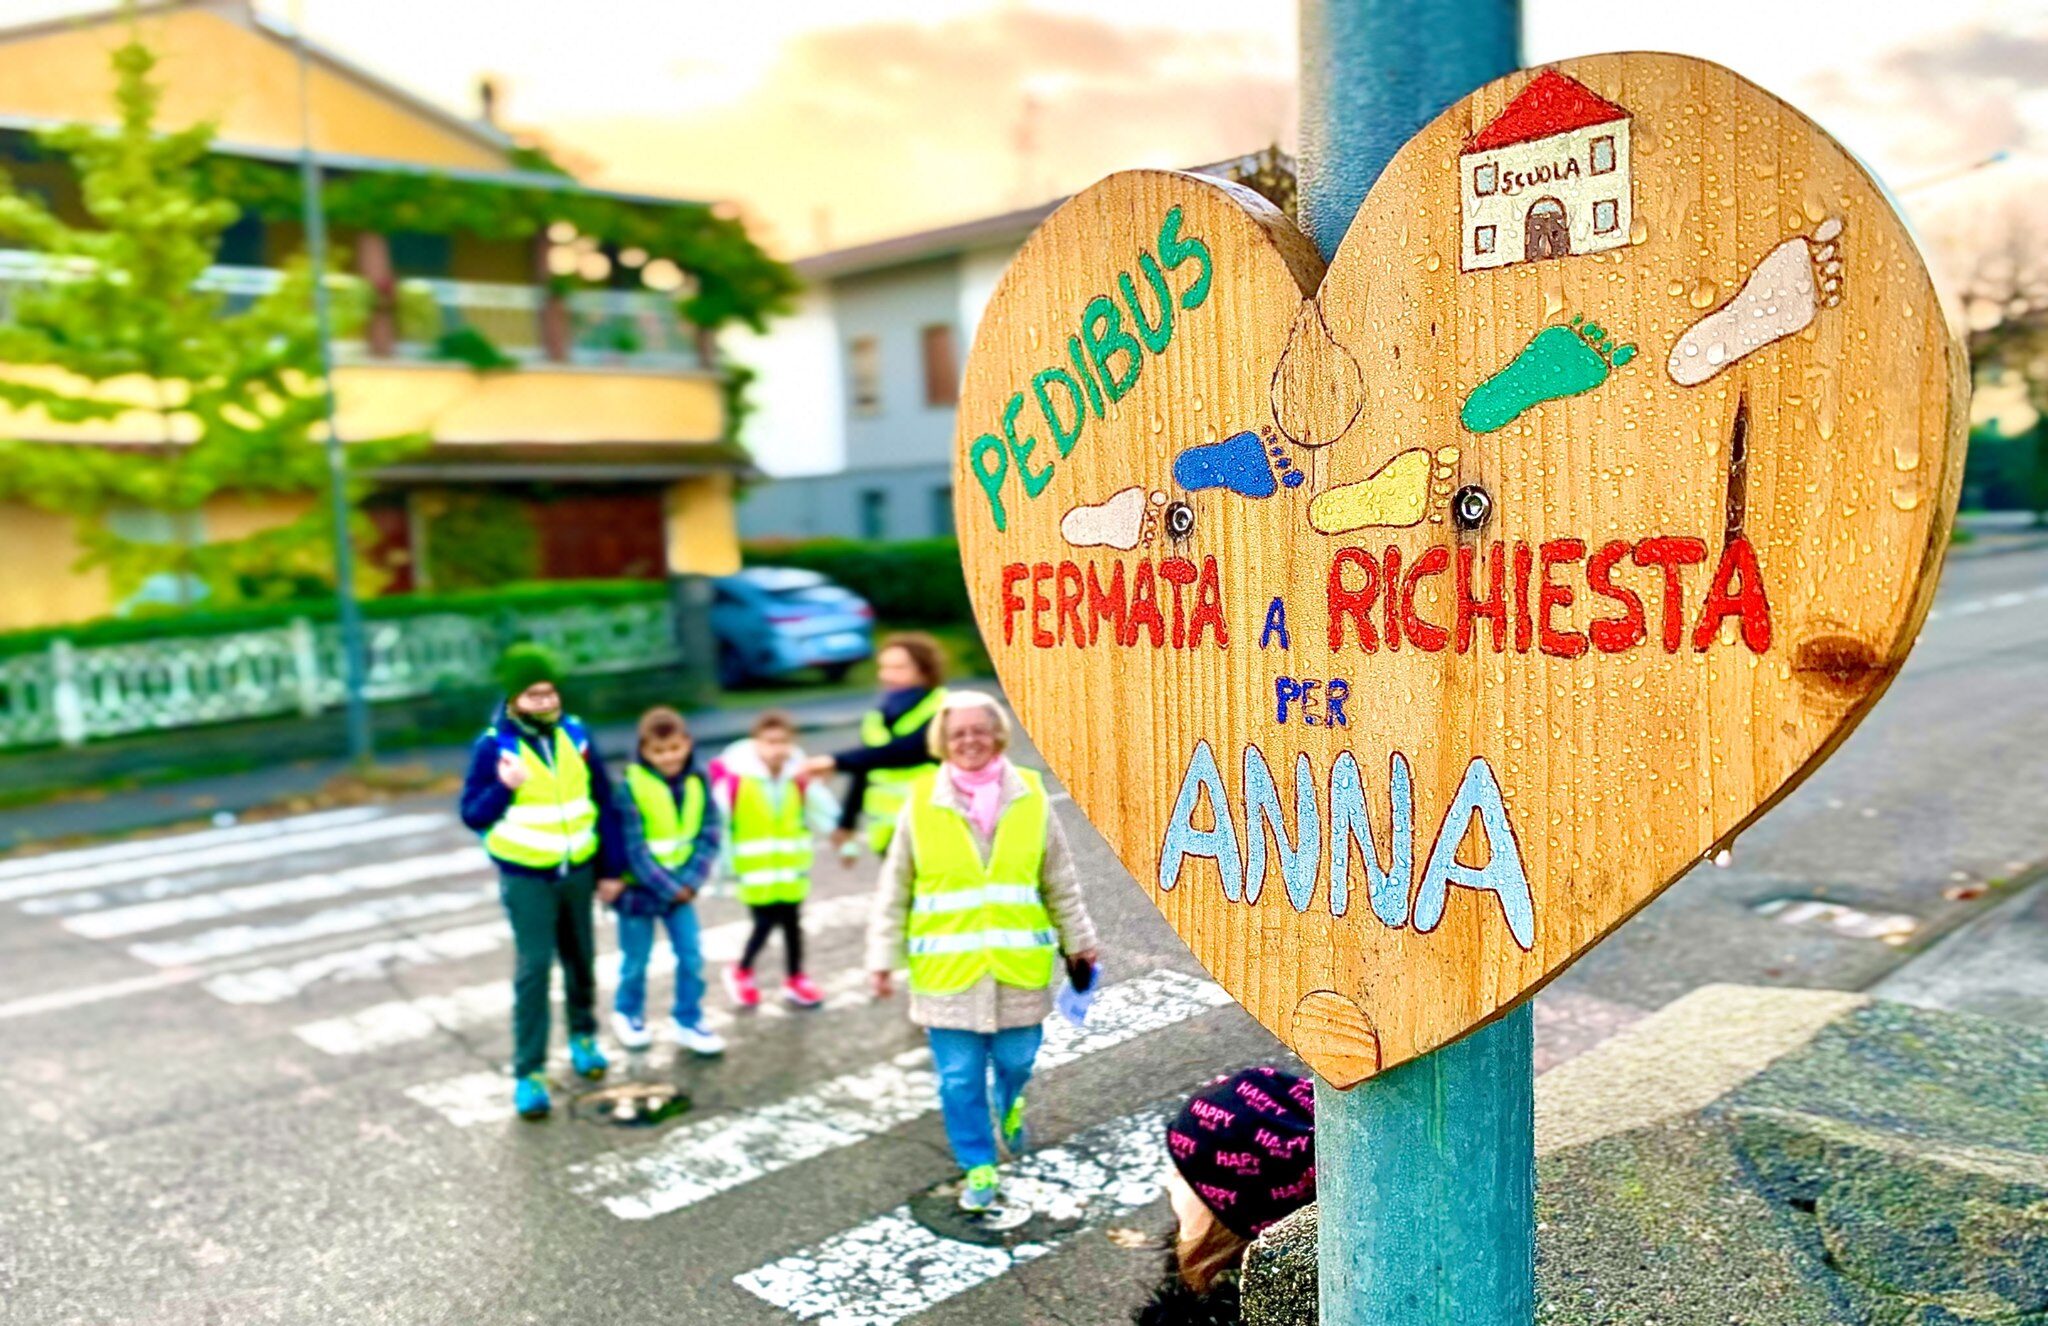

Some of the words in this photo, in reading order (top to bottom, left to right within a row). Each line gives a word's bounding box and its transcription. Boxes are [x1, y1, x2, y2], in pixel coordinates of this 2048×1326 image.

[1501, 157, 1581, 193] SCUOLA
[970, 204, 1214, 533] PEDIBUS
[1002, 554, 1229, 650] FERMATA
[1259, 596, 1291, 650] A
[1326, 536, 1772, 659] RICHIESTA
[1275, 676, 1351, 730] PER
[1158, 738, 1534, 952] ANNA
[1190, 1099, 1236, 1128] HAPPY
